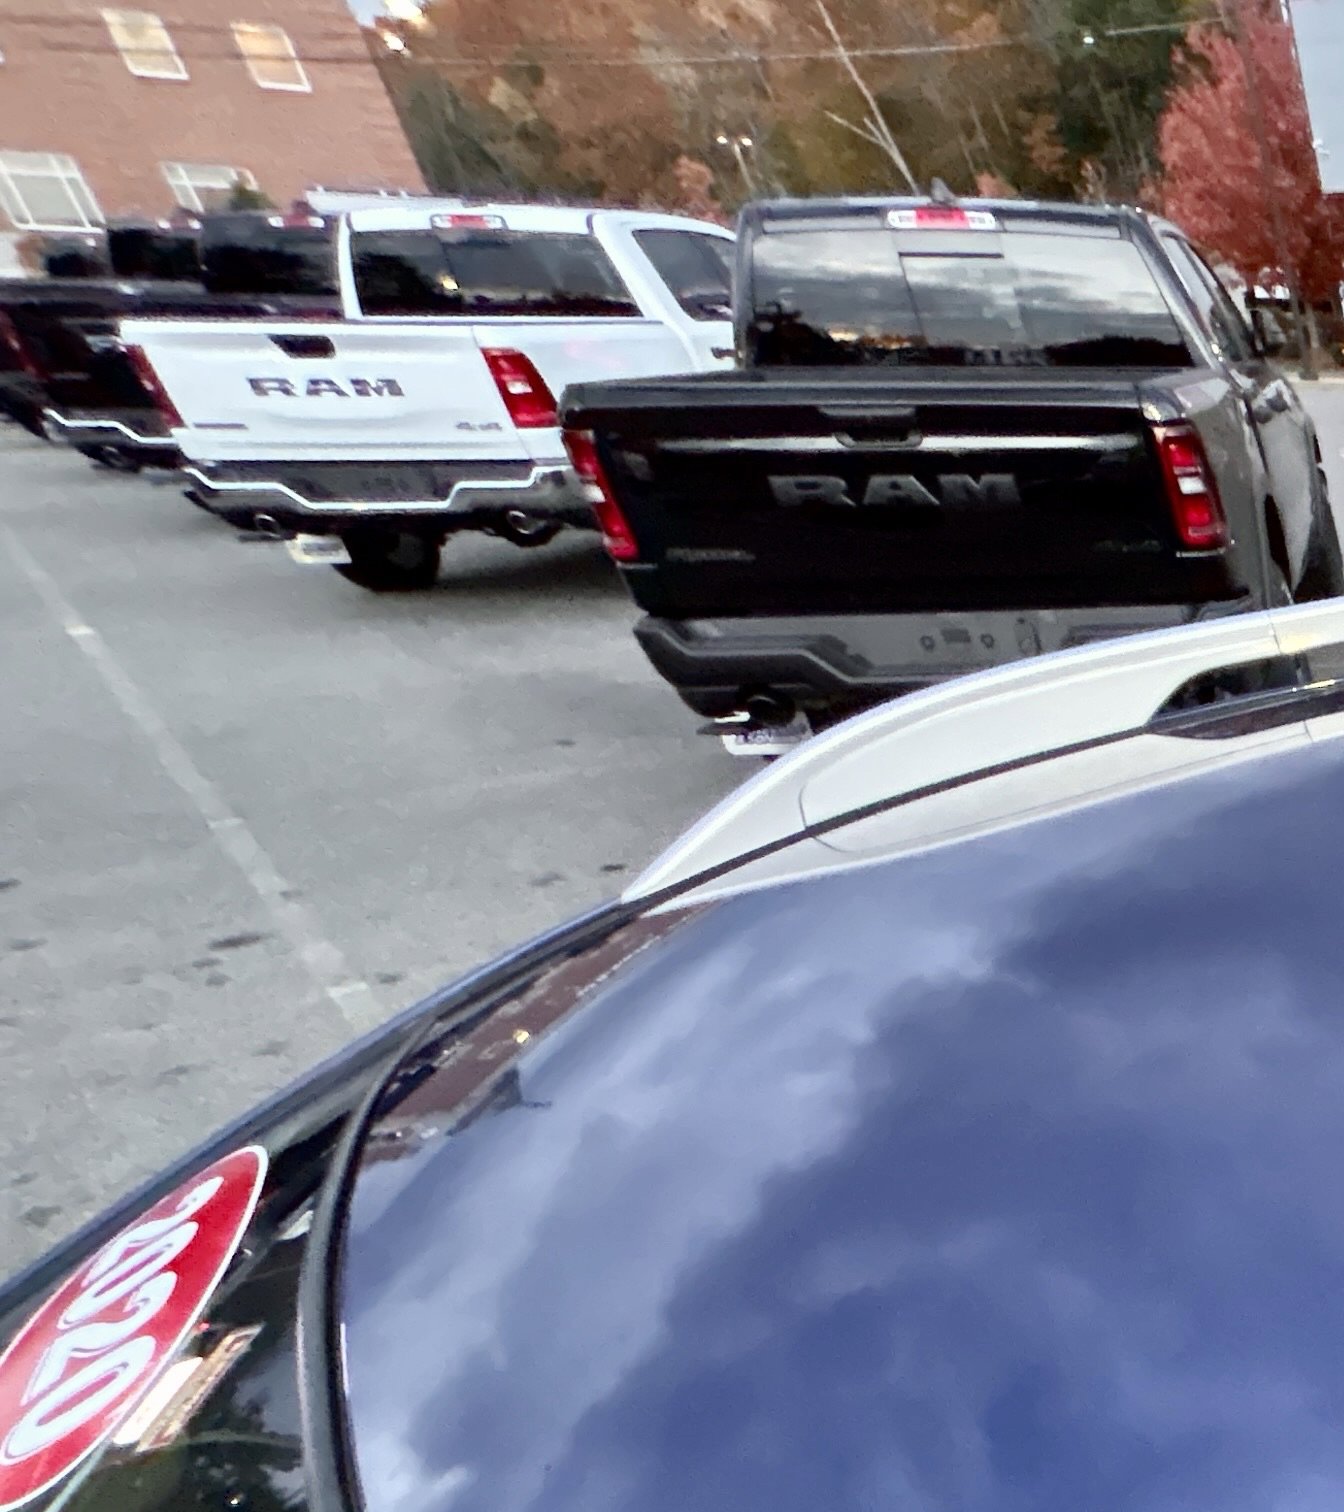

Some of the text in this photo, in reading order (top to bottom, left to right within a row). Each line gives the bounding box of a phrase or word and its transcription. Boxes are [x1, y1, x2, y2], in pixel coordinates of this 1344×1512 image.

[246, 376, 406, 397] RAM
[767, 474, 1023, 507] RAM
[1, 1176, 225, 1466] 2020
